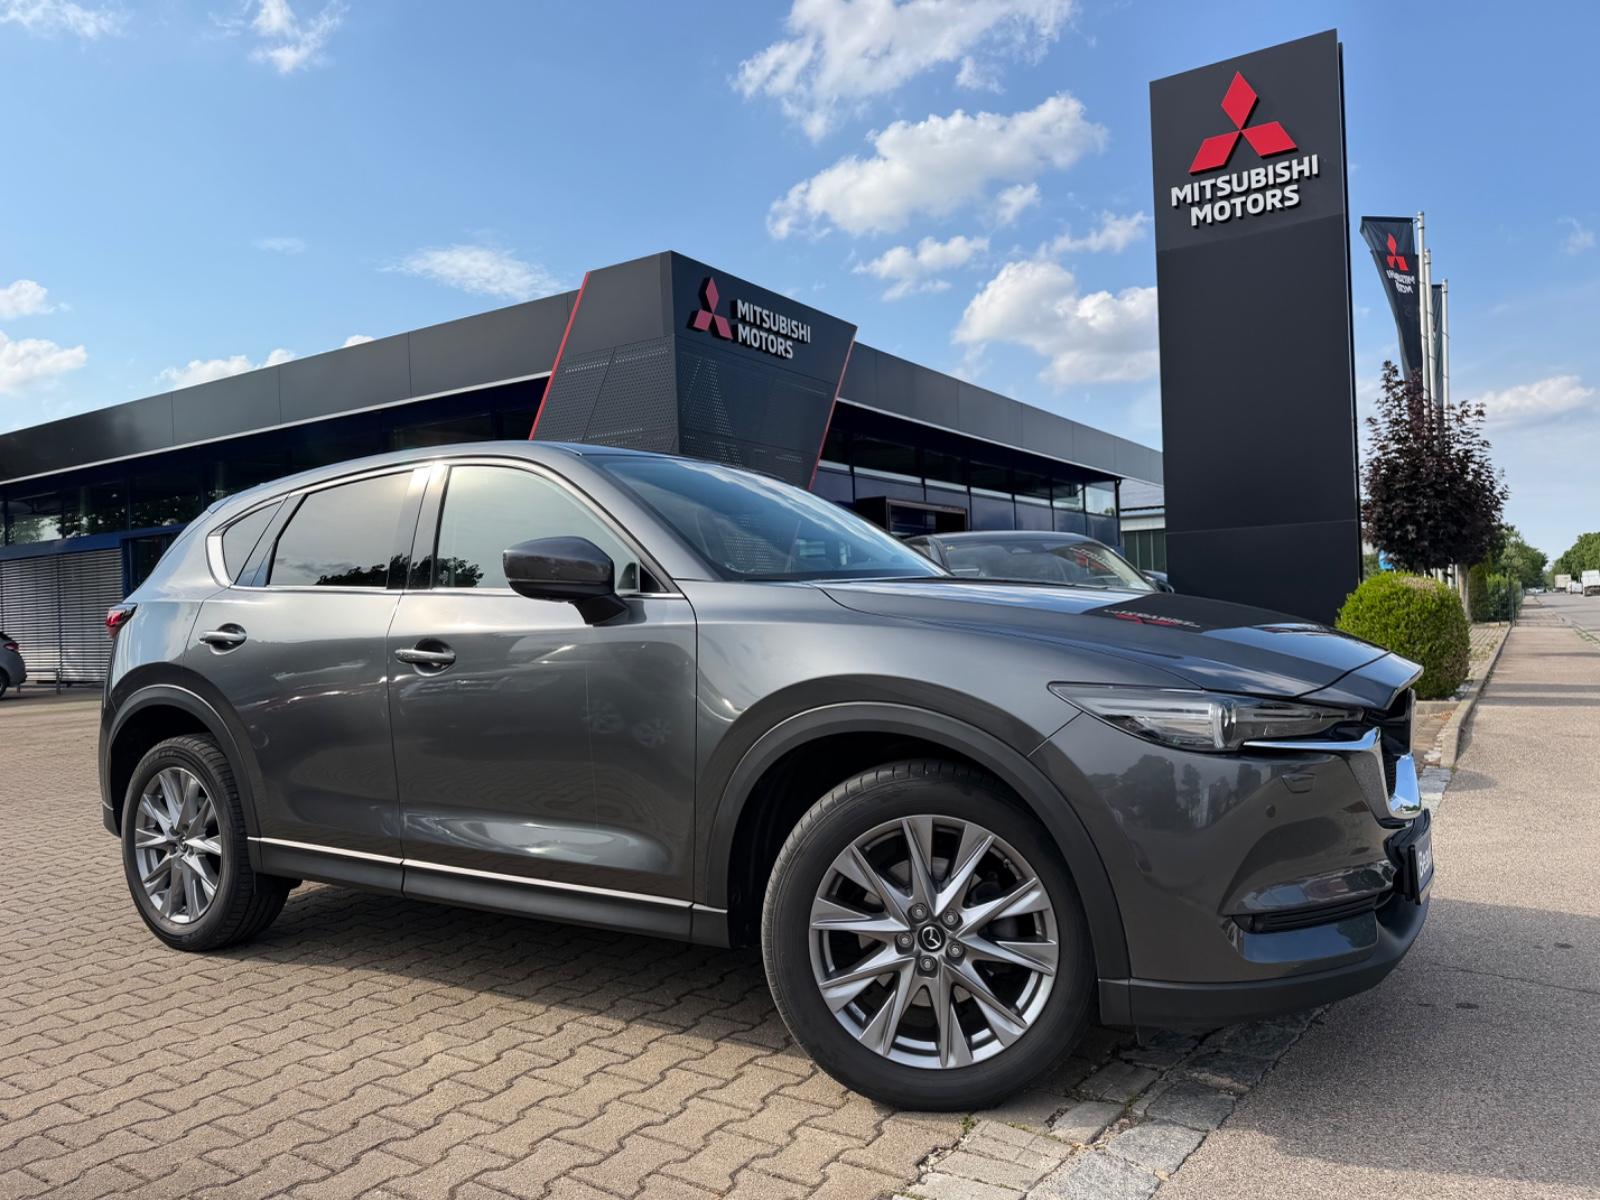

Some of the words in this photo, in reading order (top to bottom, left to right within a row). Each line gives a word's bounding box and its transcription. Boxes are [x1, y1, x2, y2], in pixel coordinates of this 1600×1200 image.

[1171, 154, 1318, 207] MITSUBISHI
[1190, 184, 1300, 226] MOTORS
[736, 298, 811, 343] MITSUBISHI
[737, 323, 793, 359] MOTORS
